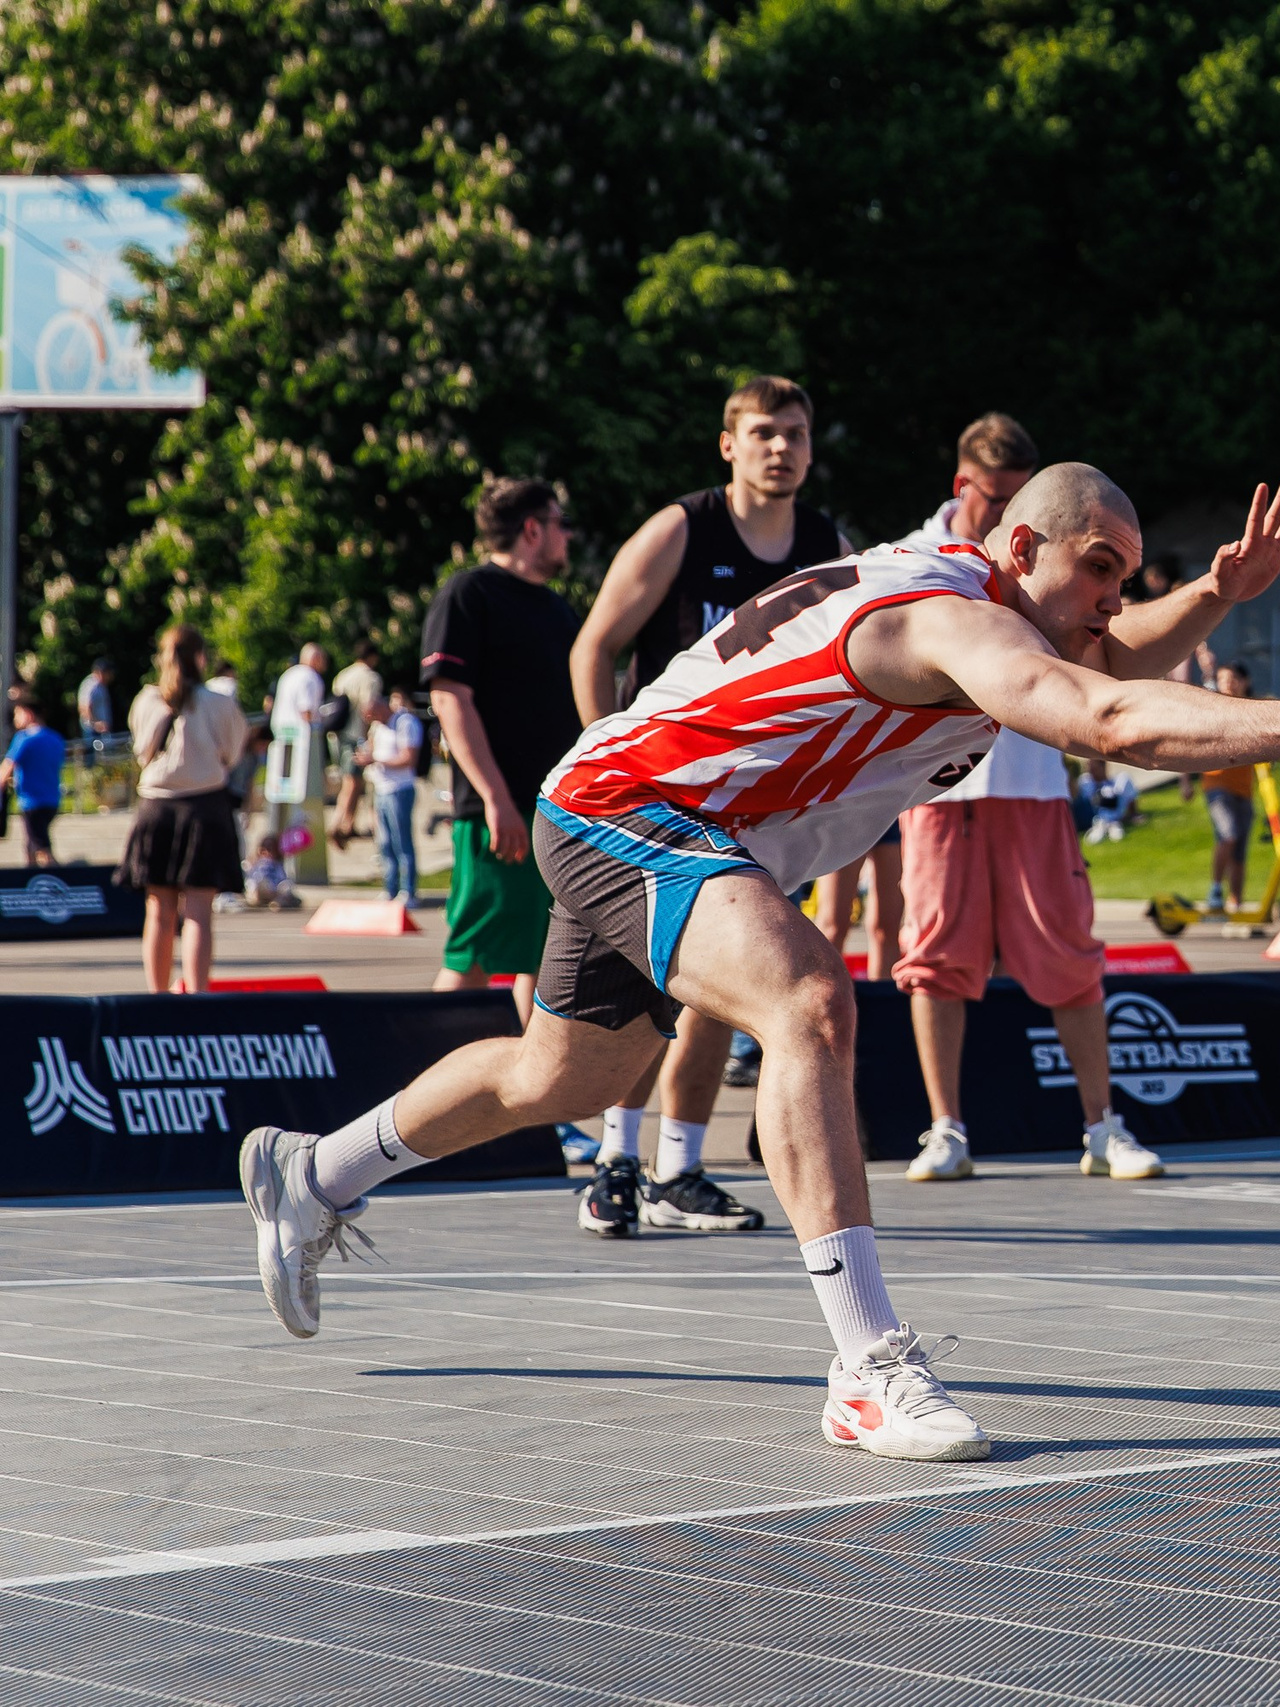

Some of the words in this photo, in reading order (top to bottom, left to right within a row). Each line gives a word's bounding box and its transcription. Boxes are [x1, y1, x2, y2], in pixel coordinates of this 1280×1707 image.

[102, 1024, 337, 1081] МОСКОВСКИЙ
[1031, 1040, 1252, 1072] STETBASKET
[118, 1086, 231, 1135] СПОРТ
